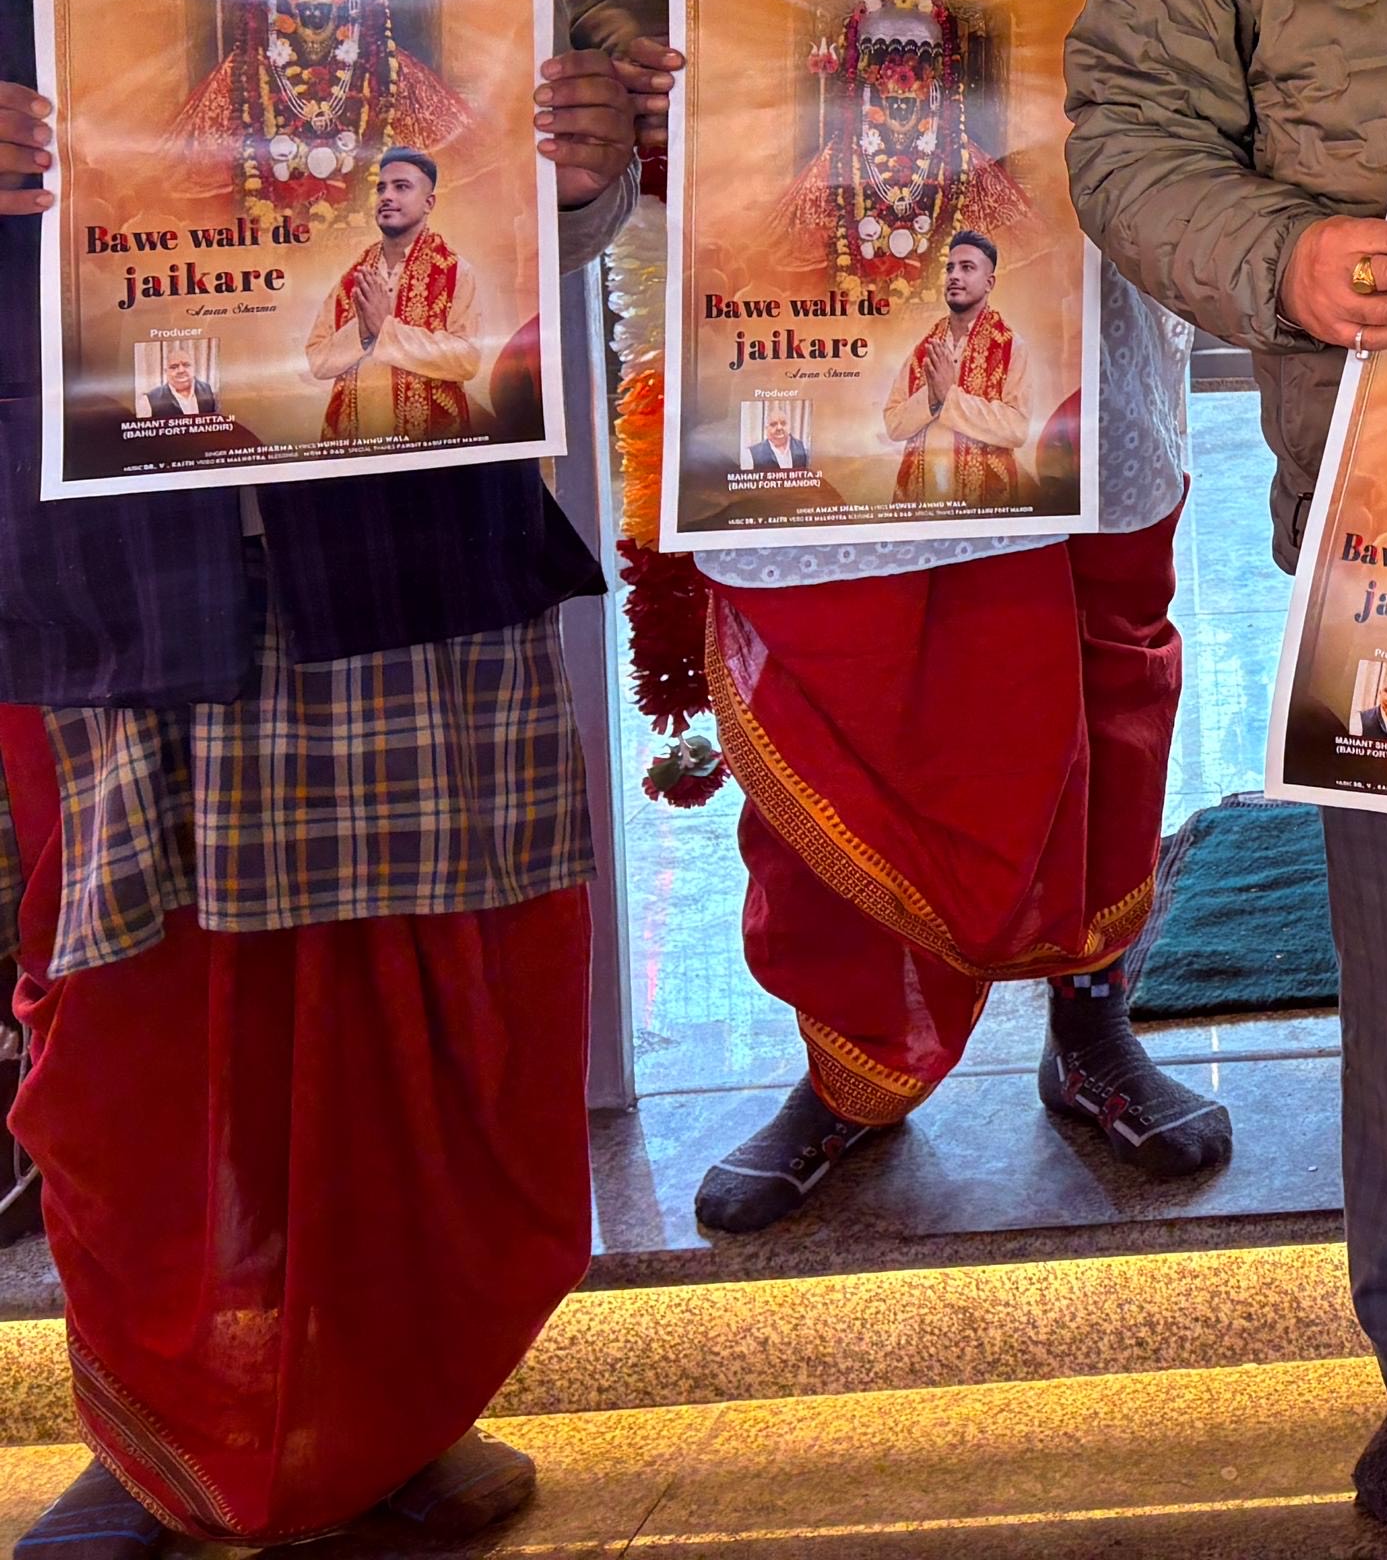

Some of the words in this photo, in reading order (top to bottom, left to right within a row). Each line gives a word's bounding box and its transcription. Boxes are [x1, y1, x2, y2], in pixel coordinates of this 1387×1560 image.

[85, 225, 178, 254] Bawe
[188, 217, 262, 247] wali
[271, 215, 311, 245] de
[118, 262, 286, 310] jaikare
[704, 293, 781, 319] Bawe
[790, 290, 849, 318] wali
[857, 290, 891, 317] de
[150, 327, 203, 338] Producer
[729, 329, 869, 371] jaikare
[754, 389, 799, 398] Producer
[121, 420, 167, 430] MAHANT
[168, 418, 193, 427] SHRI
[195, 416, 224, 425] BITTA
[123, 428, 157, 440] (BAHU
[159, 426, 186, 436] FORT
[189, 423, 234, 434] MANDIR)
[727, 473, 764, 481] MAHANT
[766, 472, 787, 480] SHRI
[789, 471, 814, 479] BITTA
[758, 480, 781, 489] FORT
[783, 479, 821, 488] MANDIR)
[1335, 736, 1374, 748] MAHANT
